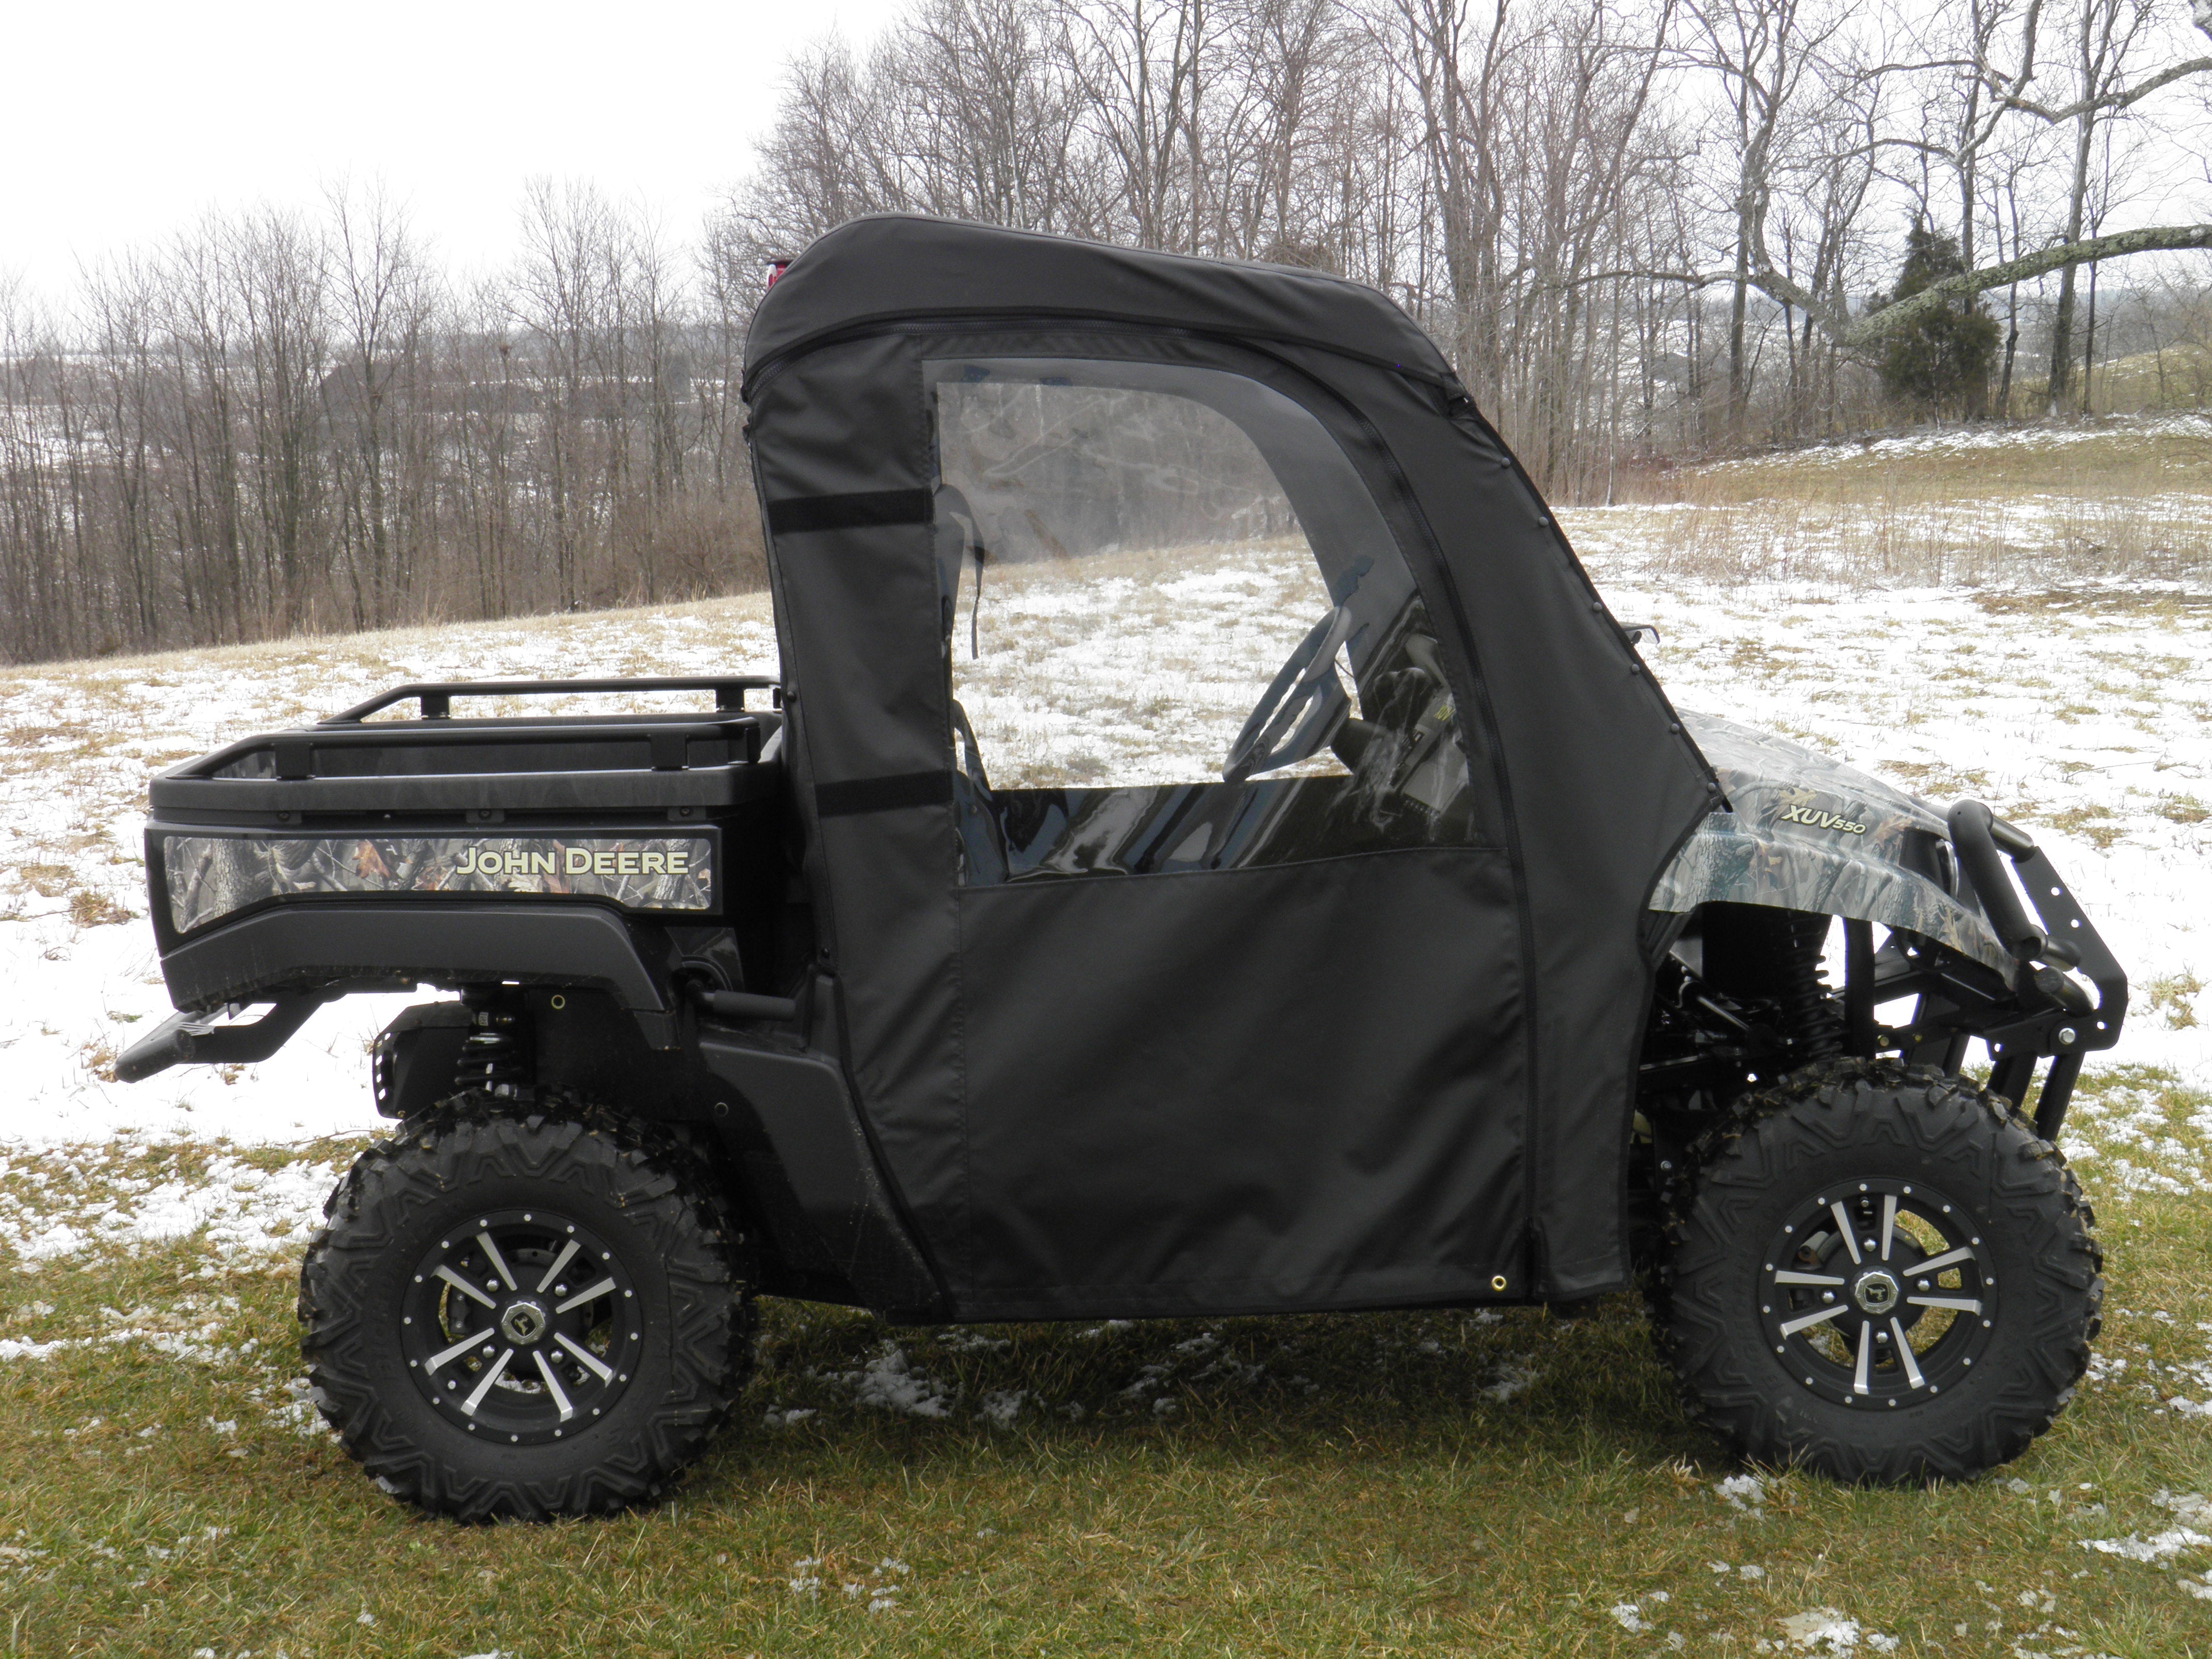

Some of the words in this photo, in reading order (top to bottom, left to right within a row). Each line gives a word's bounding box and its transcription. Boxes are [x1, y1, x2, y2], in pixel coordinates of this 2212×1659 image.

[1781, 804, 1867, 835] XUV550
[457, 847, 556, 875] JOHN
[565, 847, 689, 875] DEERE
